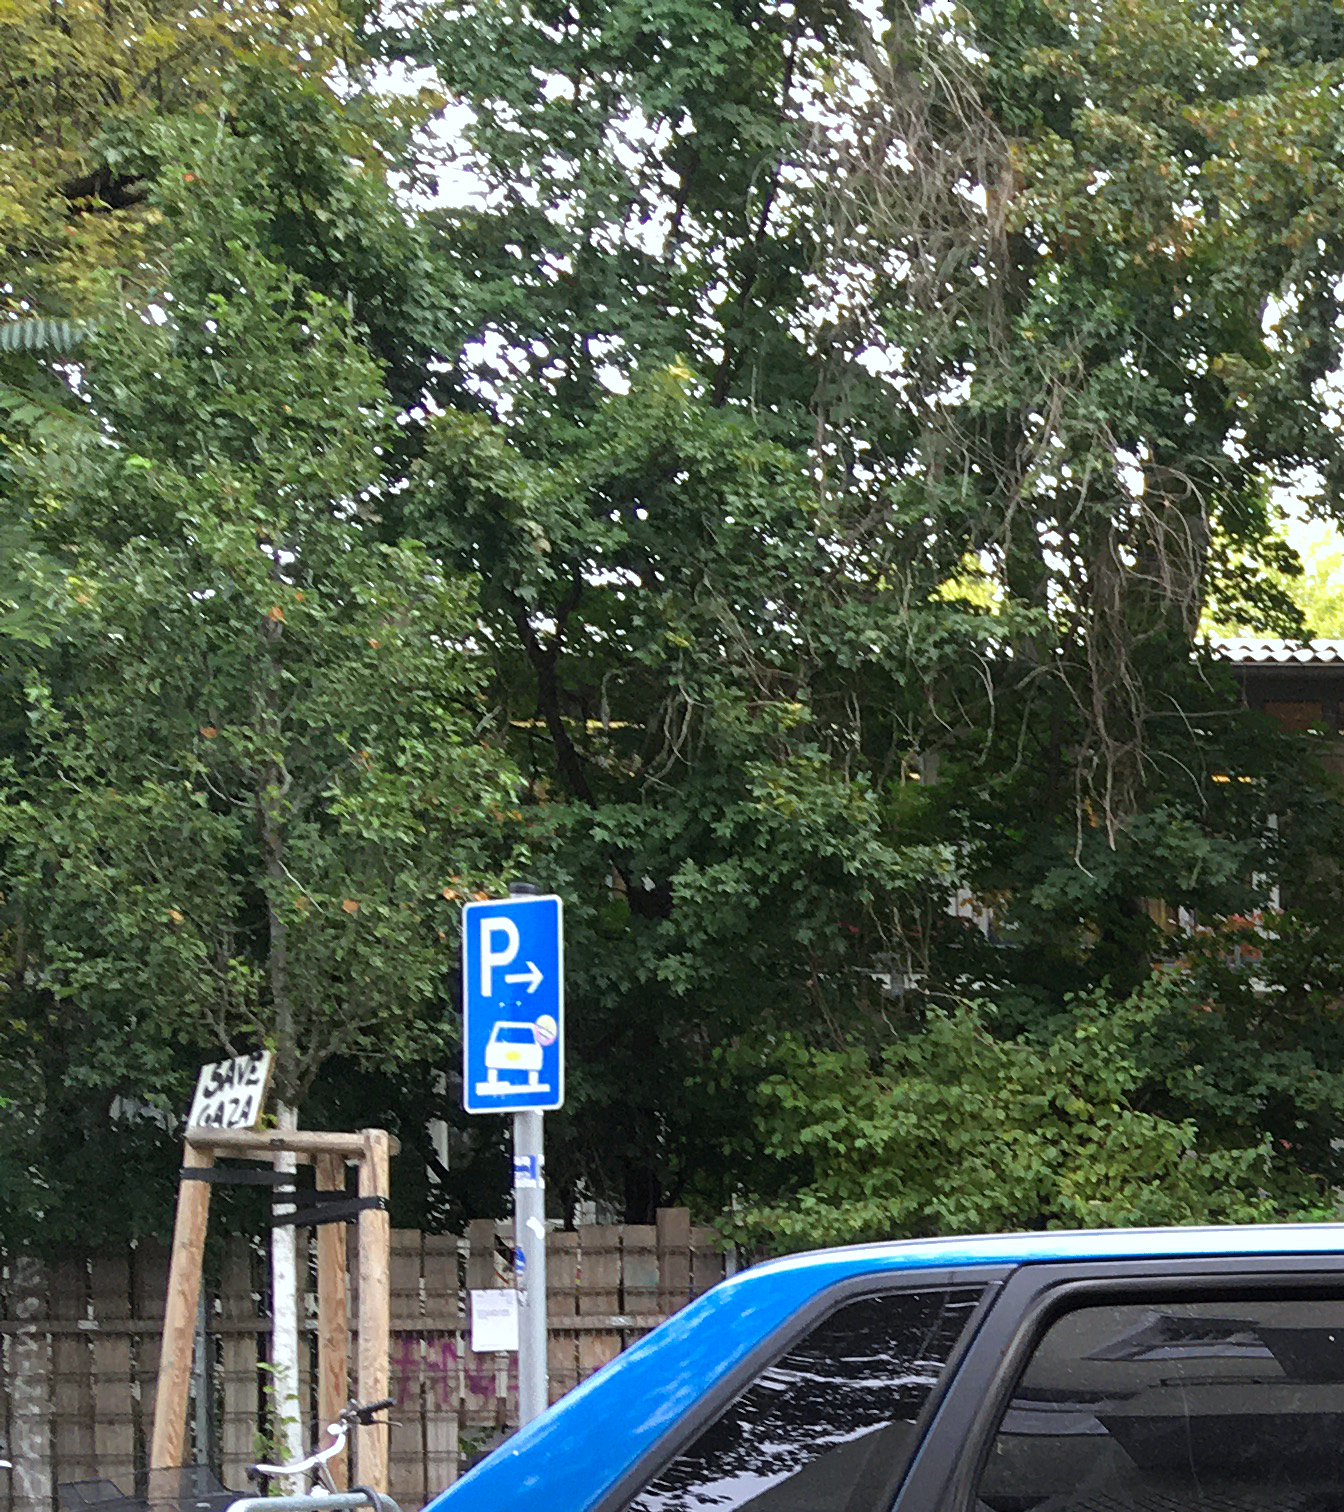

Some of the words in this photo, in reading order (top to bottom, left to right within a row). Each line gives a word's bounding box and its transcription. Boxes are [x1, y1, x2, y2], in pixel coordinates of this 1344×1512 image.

[480, 916, 520, 997] P
[203, 1050, 263, 1098] SAVE
[196, 1095, 253, 1129] GAZA
